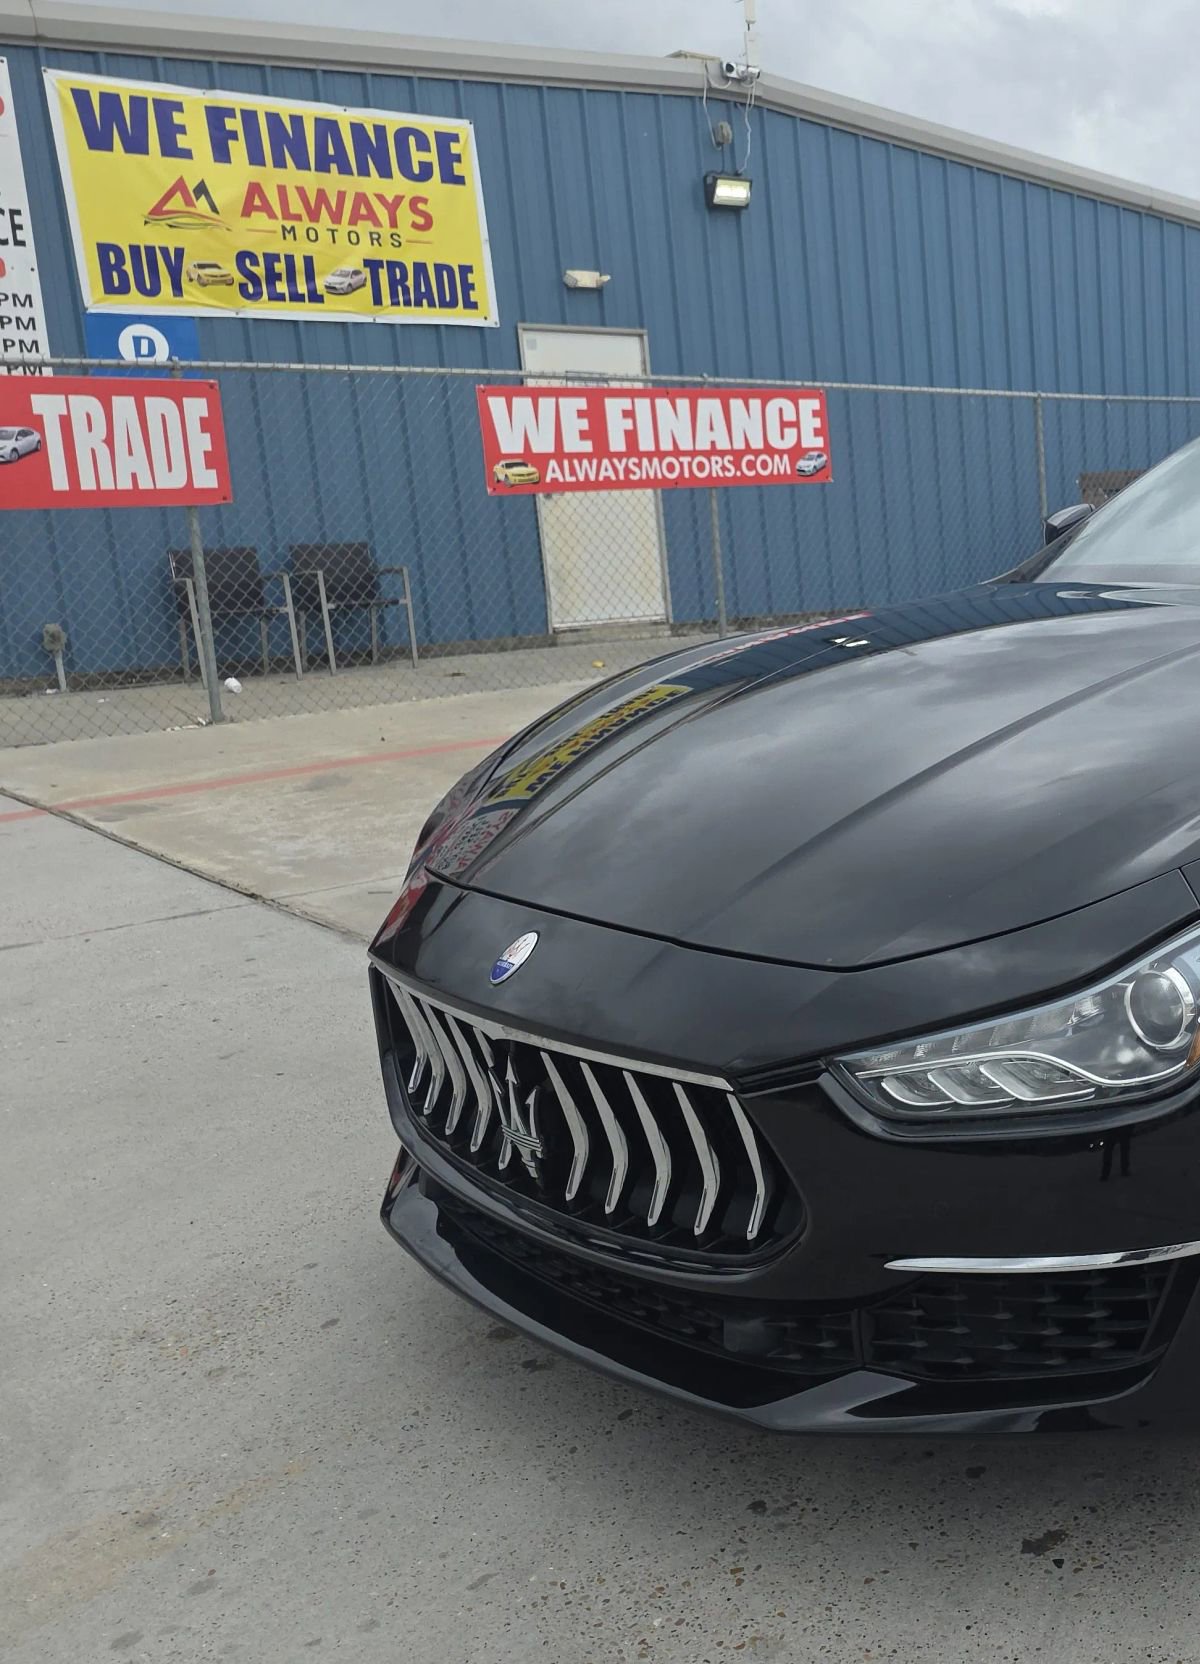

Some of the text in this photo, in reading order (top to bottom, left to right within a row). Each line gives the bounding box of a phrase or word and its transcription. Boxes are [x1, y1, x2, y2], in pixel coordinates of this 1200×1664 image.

[70, 88, 466, 186] WE FINANCE
[240, 181, 434, 232] ALWAYS
[281, 224, 402, 248] MOTORS
[96, 242, 479, 310] BUY SELL TRADE
[0, 315, 37, 331] PM
[3, 338, 40, 354] PM
[30, 393, 219, 491] TRADE
[487, 396, 824, 454] WE FINANCE
[545, 453, 792, 484] ALWAYSMOTORS.COM
